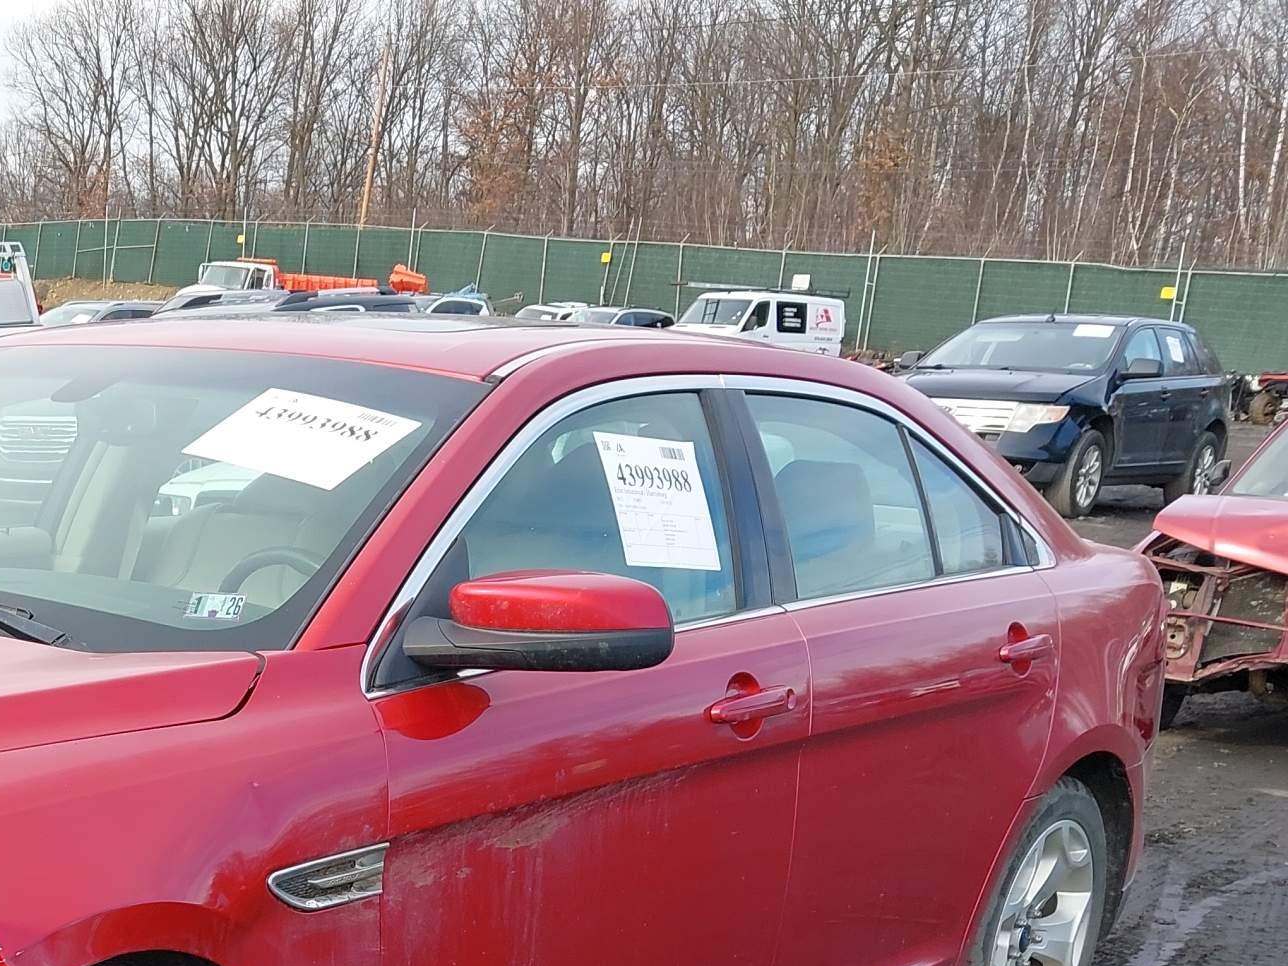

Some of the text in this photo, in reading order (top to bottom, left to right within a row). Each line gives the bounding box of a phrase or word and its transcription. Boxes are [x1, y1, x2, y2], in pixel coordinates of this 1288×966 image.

[255, 405, 379, 442] 43993988
[616, 463, 693, 493] 43993988
[225, 596, 244, 616] 26
